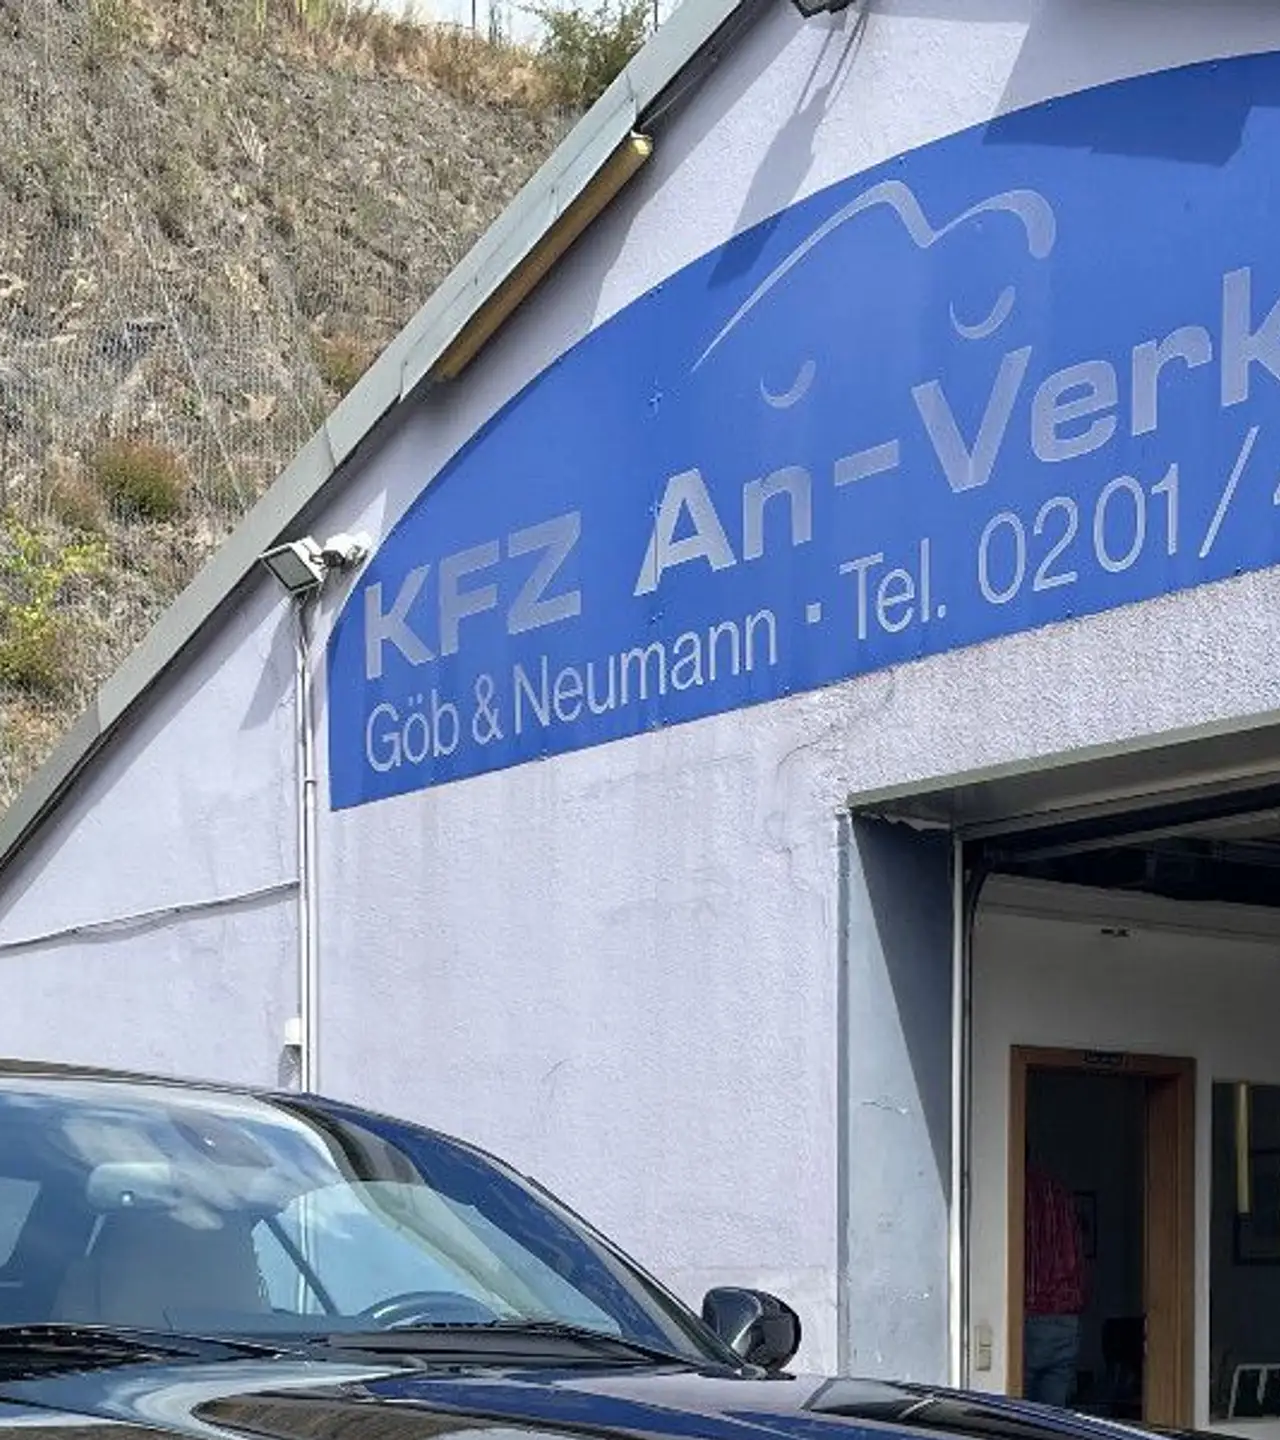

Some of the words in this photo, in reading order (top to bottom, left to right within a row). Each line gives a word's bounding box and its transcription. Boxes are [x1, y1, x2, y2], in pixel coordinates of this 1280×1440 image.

[364, 511, 582, 680] KFZ
[366, 688, 460, 772] Göb
[471, 673, 503, 745] &
[512, 606, 778, 735] Neumann
[839, 537, 947, 640] Tel.
